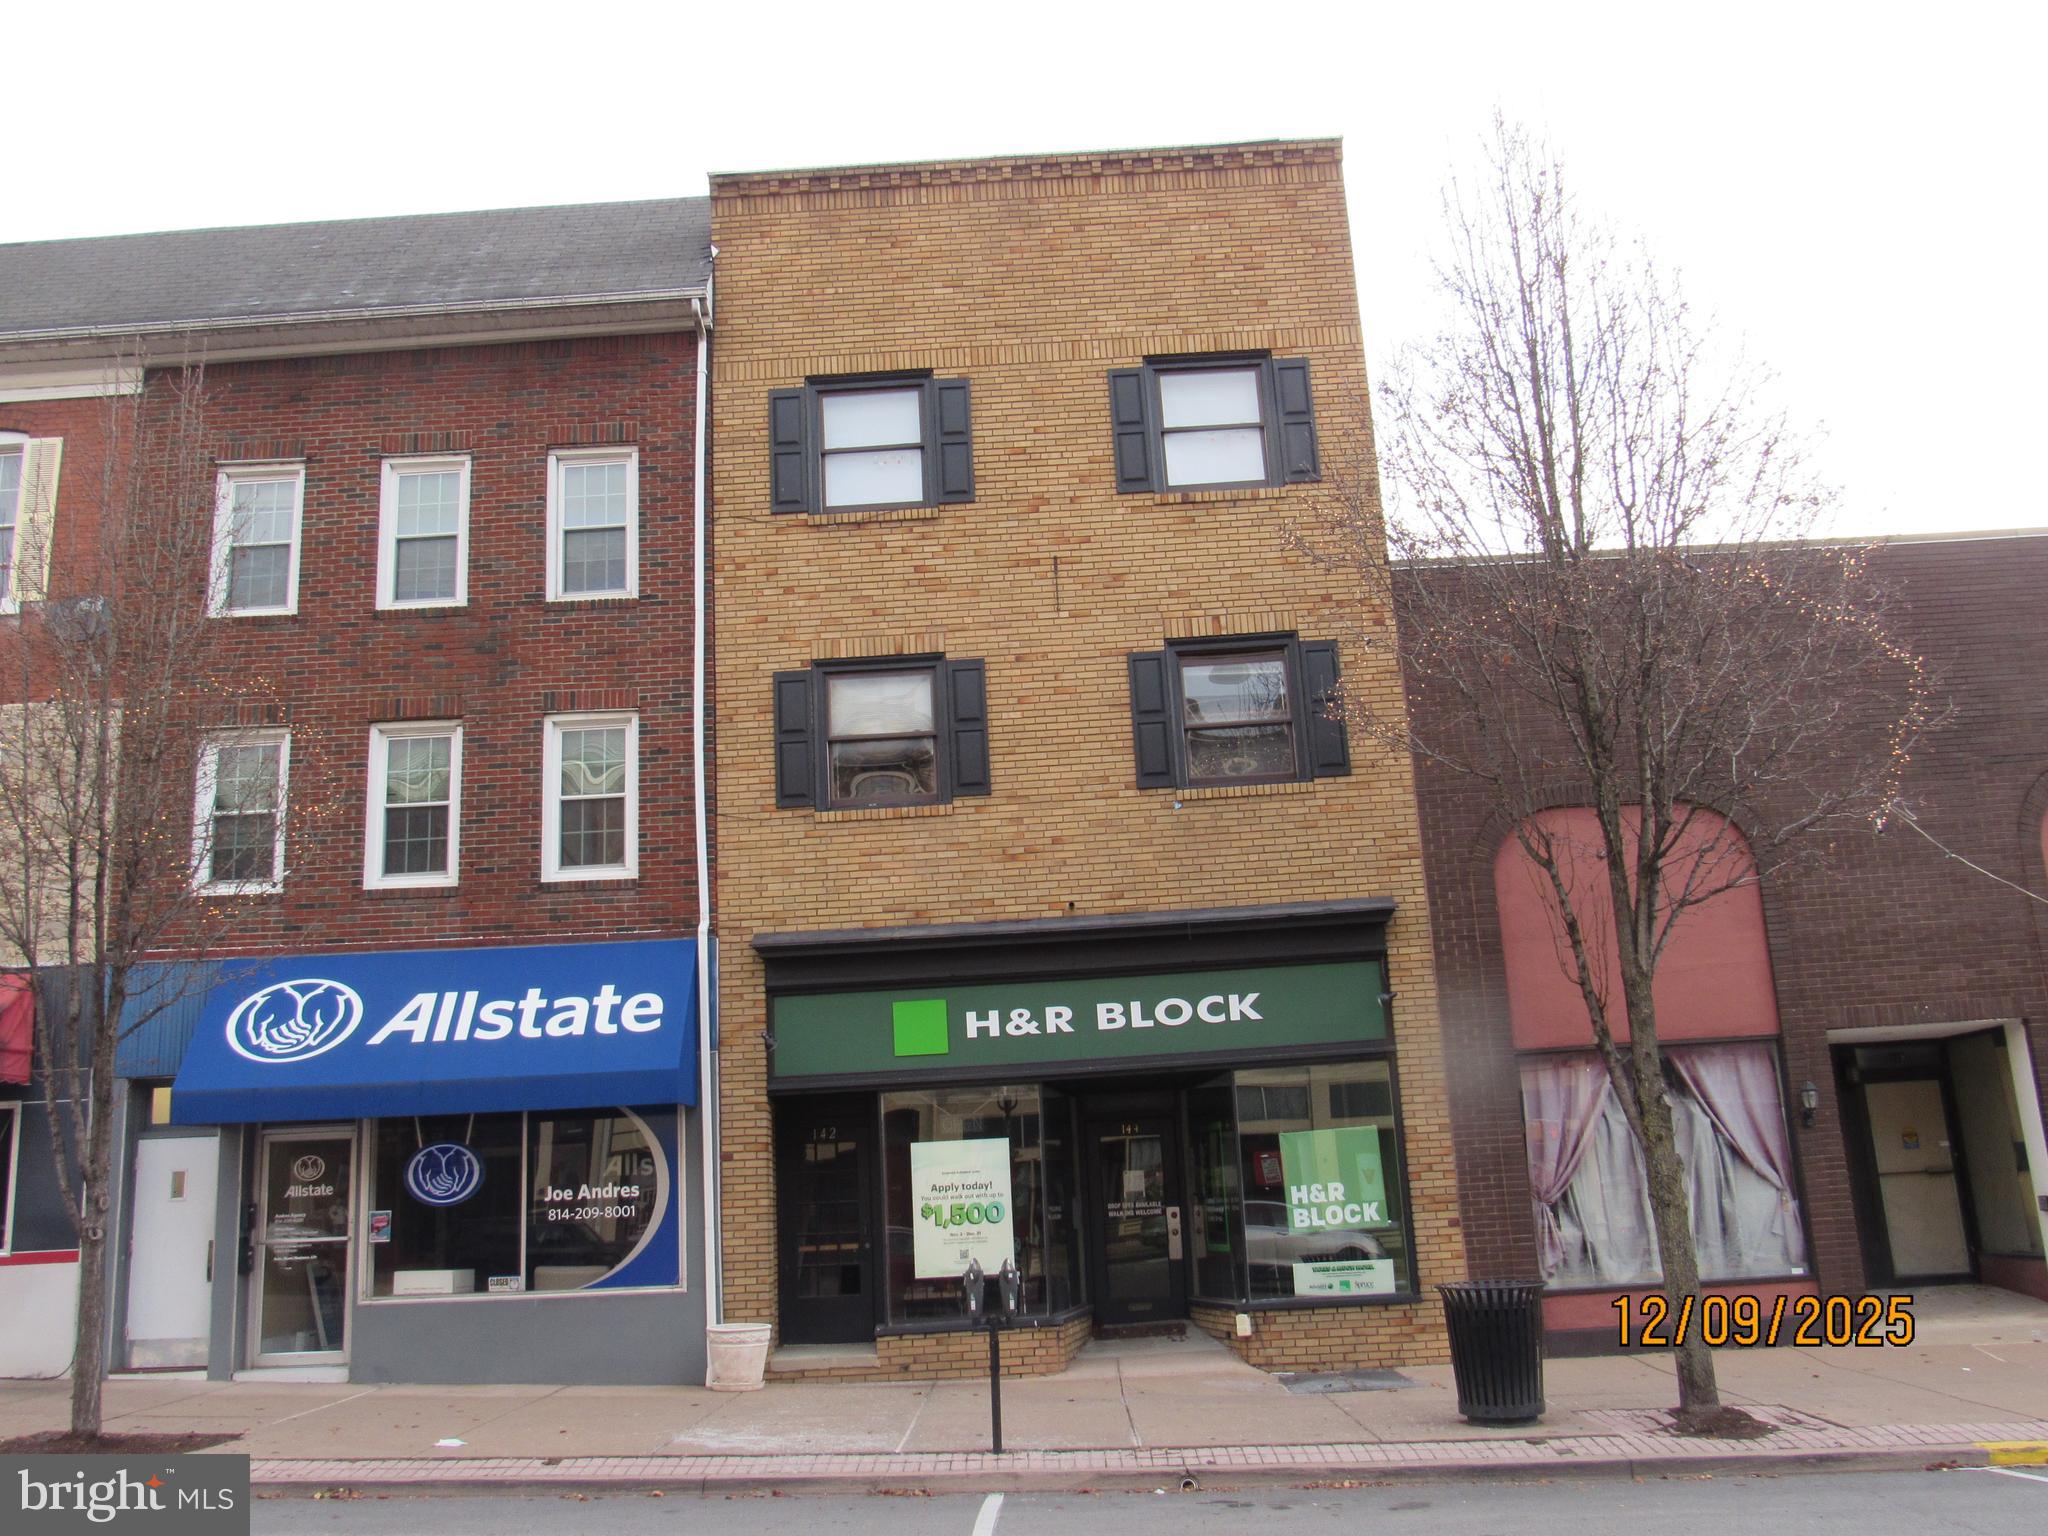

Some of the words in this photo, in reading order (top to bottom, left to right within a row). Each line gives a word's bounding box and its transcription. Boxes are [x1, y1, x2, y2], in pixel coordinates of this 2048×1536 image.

[366, 984, 664, 1045] Allstate
[965, 1005, 1075, 1039] H&R
[1096, 992, 1264, 1031] BLOCK
[813, 1126, 837, 1140] 142
[283, 1183, 334, 1198] Allstate
[544, 1186, 573, 1202] Joe
[578, 1182, 640, 1200] Andres
[931, 1183, 960, 1194] Apply
[962, 1180, 993, 1191] today!
[1290, 1181, 1346, 1206] H&R
[548, 1205, 636, 1221] 814-209-8001
[920, 1201, 1006, 1229] $1,500
[1292, 1201, 1381, 1228] BLOCK
